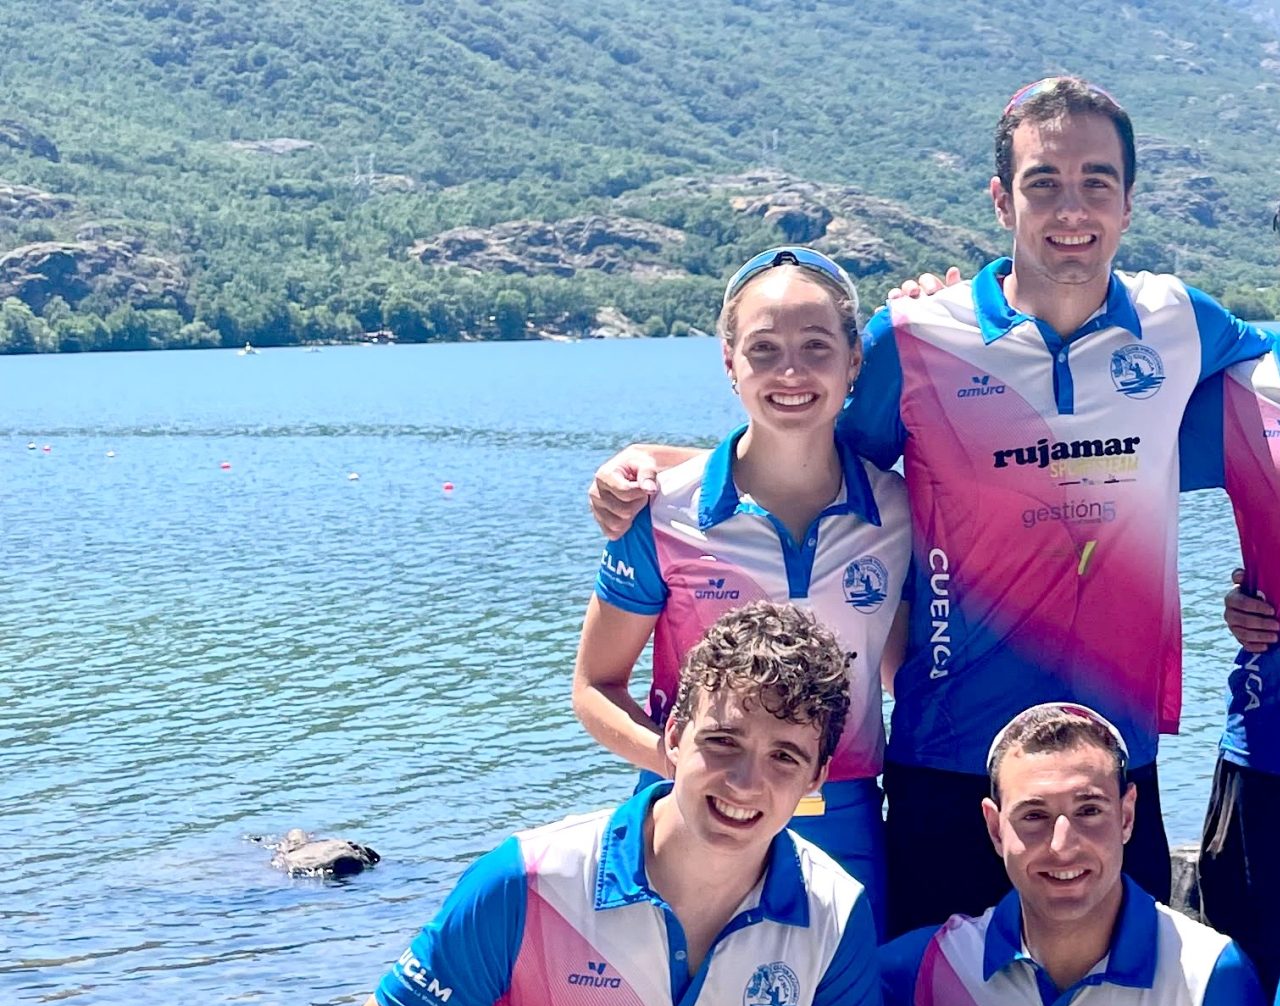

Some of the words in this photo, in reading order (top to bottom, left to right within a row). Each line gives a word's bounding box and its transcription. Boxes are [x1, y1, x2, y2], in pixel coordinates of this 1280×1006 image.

[957, 385, 1005, 398] amura
[993, 437, 1140, 468] rujamar
[601, 549, 634, 579] CLM
[695, 589, 739, 599] amura
[929, 548, 950, 679] CUENCA
[568, 974, 621, 988] amura
